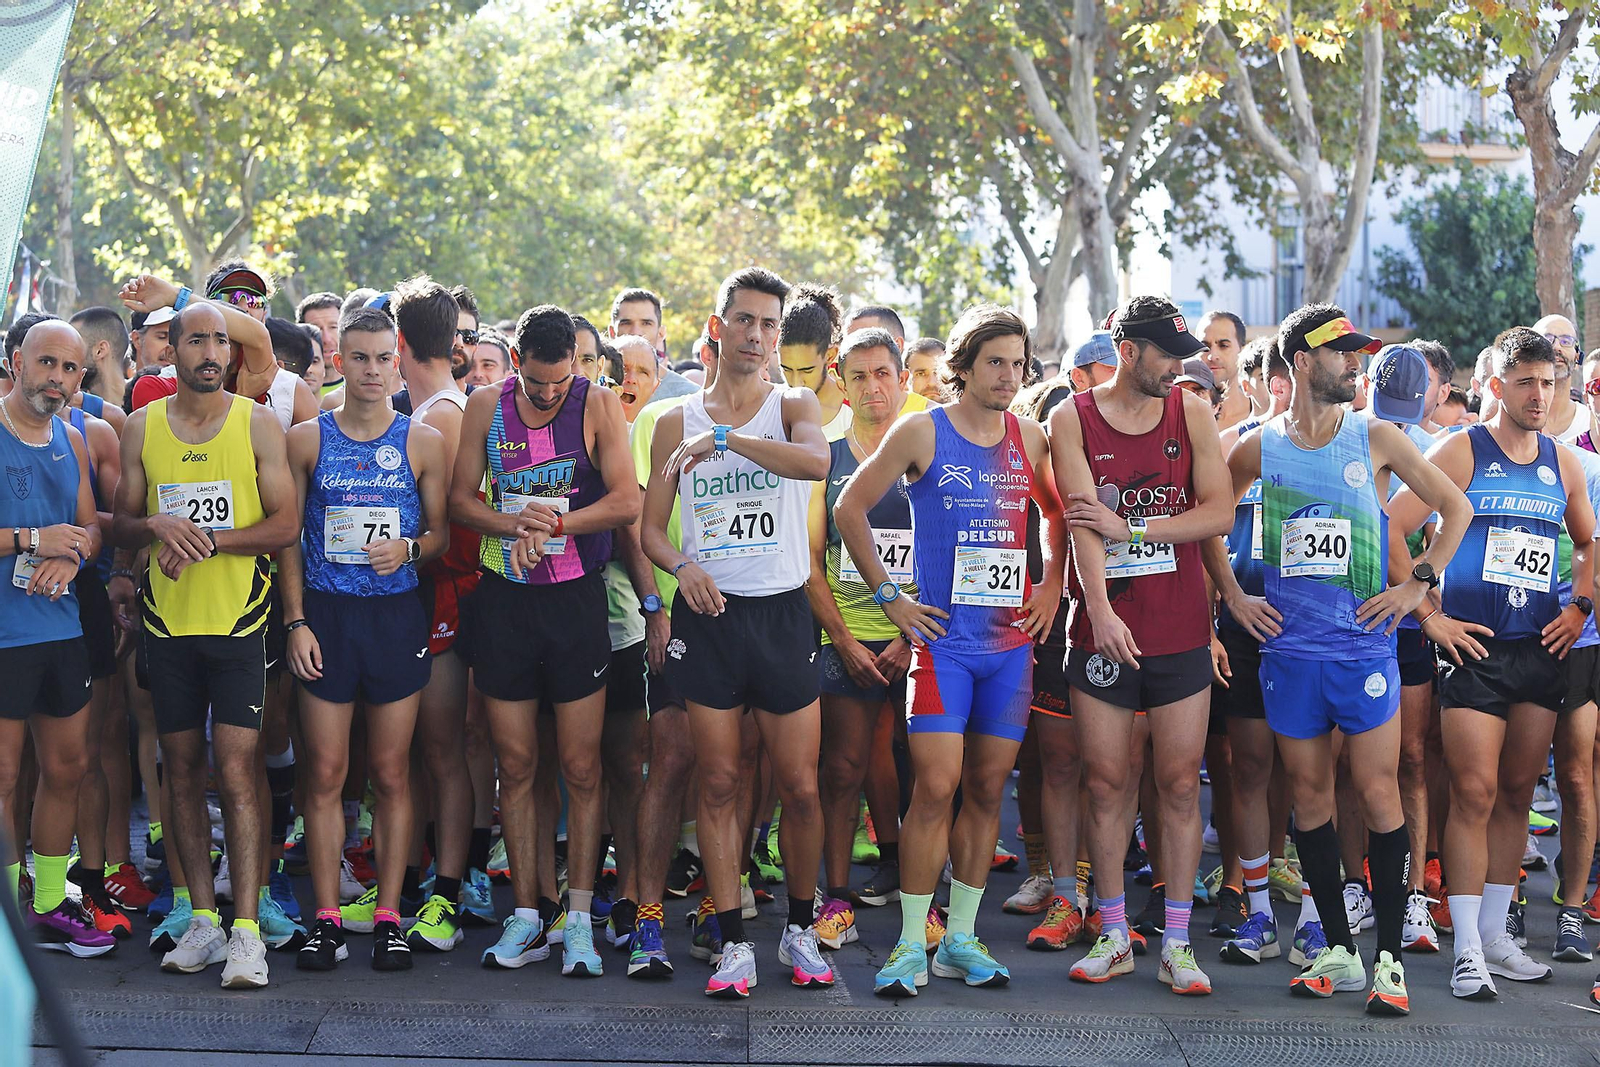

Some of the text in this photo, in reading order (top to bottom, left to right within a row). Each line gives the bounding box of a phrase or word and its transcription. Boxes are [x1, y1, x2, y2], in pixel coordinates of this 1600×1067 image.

[693, 467, 780, 498] bathco
[736, 500, 763, 509] ENRIQUE
[1121, 486, 1188, 507] COSTA
[1479, 495, 1561, 517] CT.ALMONTE
[187, 496, 229, 523] 239
[363, 523, 392, 545] 75
[728, 512, 775, 540] 470
[969, 519, 1010, 527] ATLETISMO
[957, 530, 1016, 543] DELSUR
[1303, 533, 1347, 559] 340
[1000, 552, 1015, 560] PABLO
[1128, 541, 1171, 559] 454
[1513, 548, 1551, 577] 452
[987, 564, 1021, 590] 321
